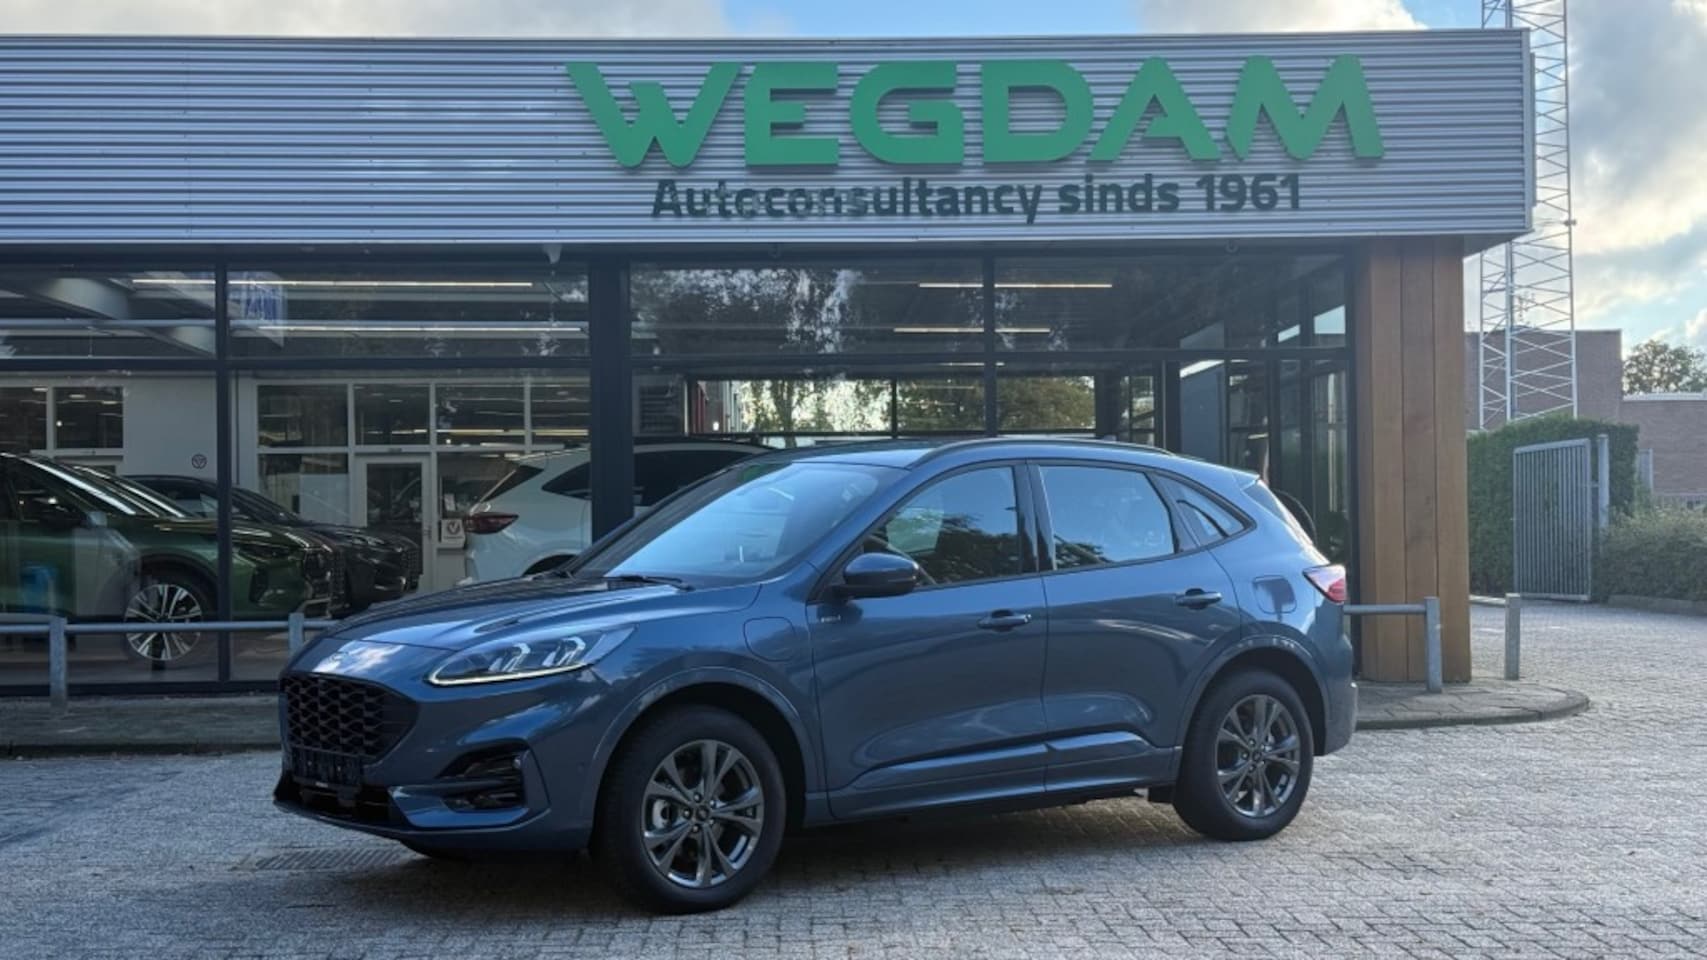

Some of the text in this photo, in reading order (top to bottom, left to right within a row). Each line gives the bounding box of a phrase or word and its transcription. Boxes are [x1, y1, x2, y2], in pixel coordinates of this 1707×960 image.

[566, 55, 1385, 168] WEGDAM
[652, 172, 1300, 225] Autoconsultancy sinds 1961
